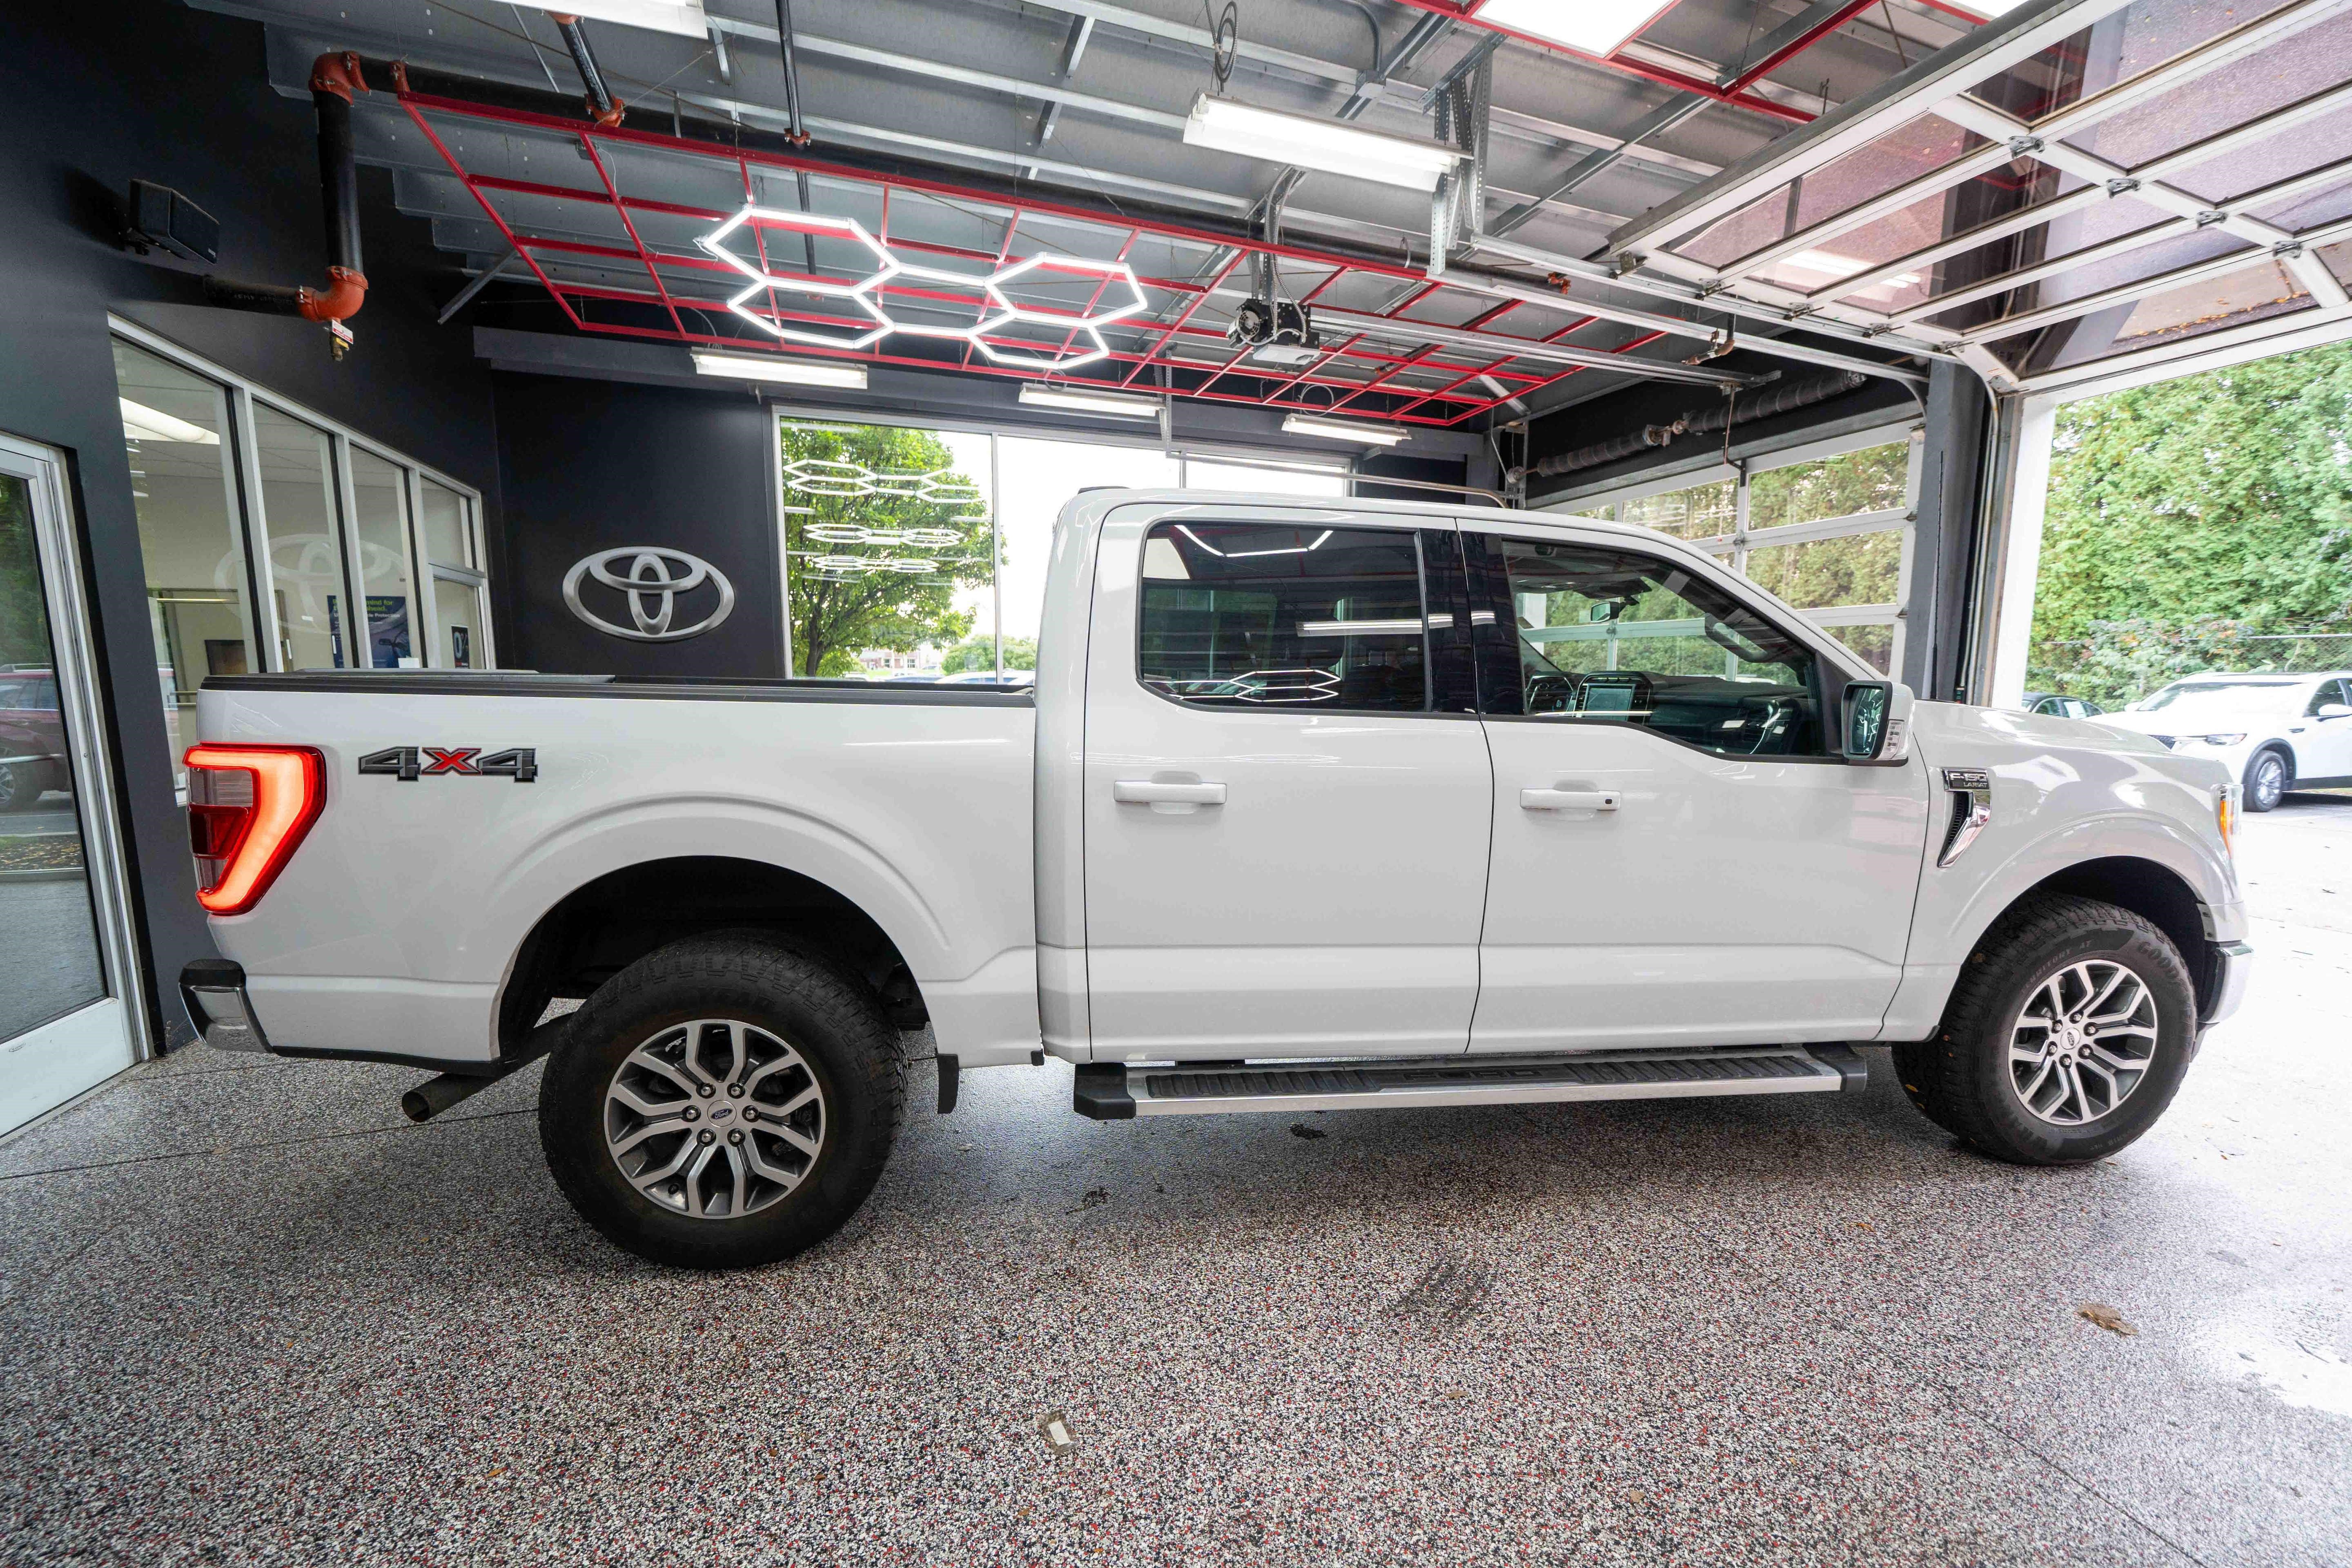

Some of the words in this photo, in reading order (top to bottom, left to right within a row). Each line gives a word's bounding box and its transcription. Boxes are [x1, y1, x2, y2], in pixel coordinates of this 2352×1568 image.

[358, 746, 538, 783] 4X4
[1949, 773, 1988, 782] F-150
[714, 1109, 728, 1119] Ford
